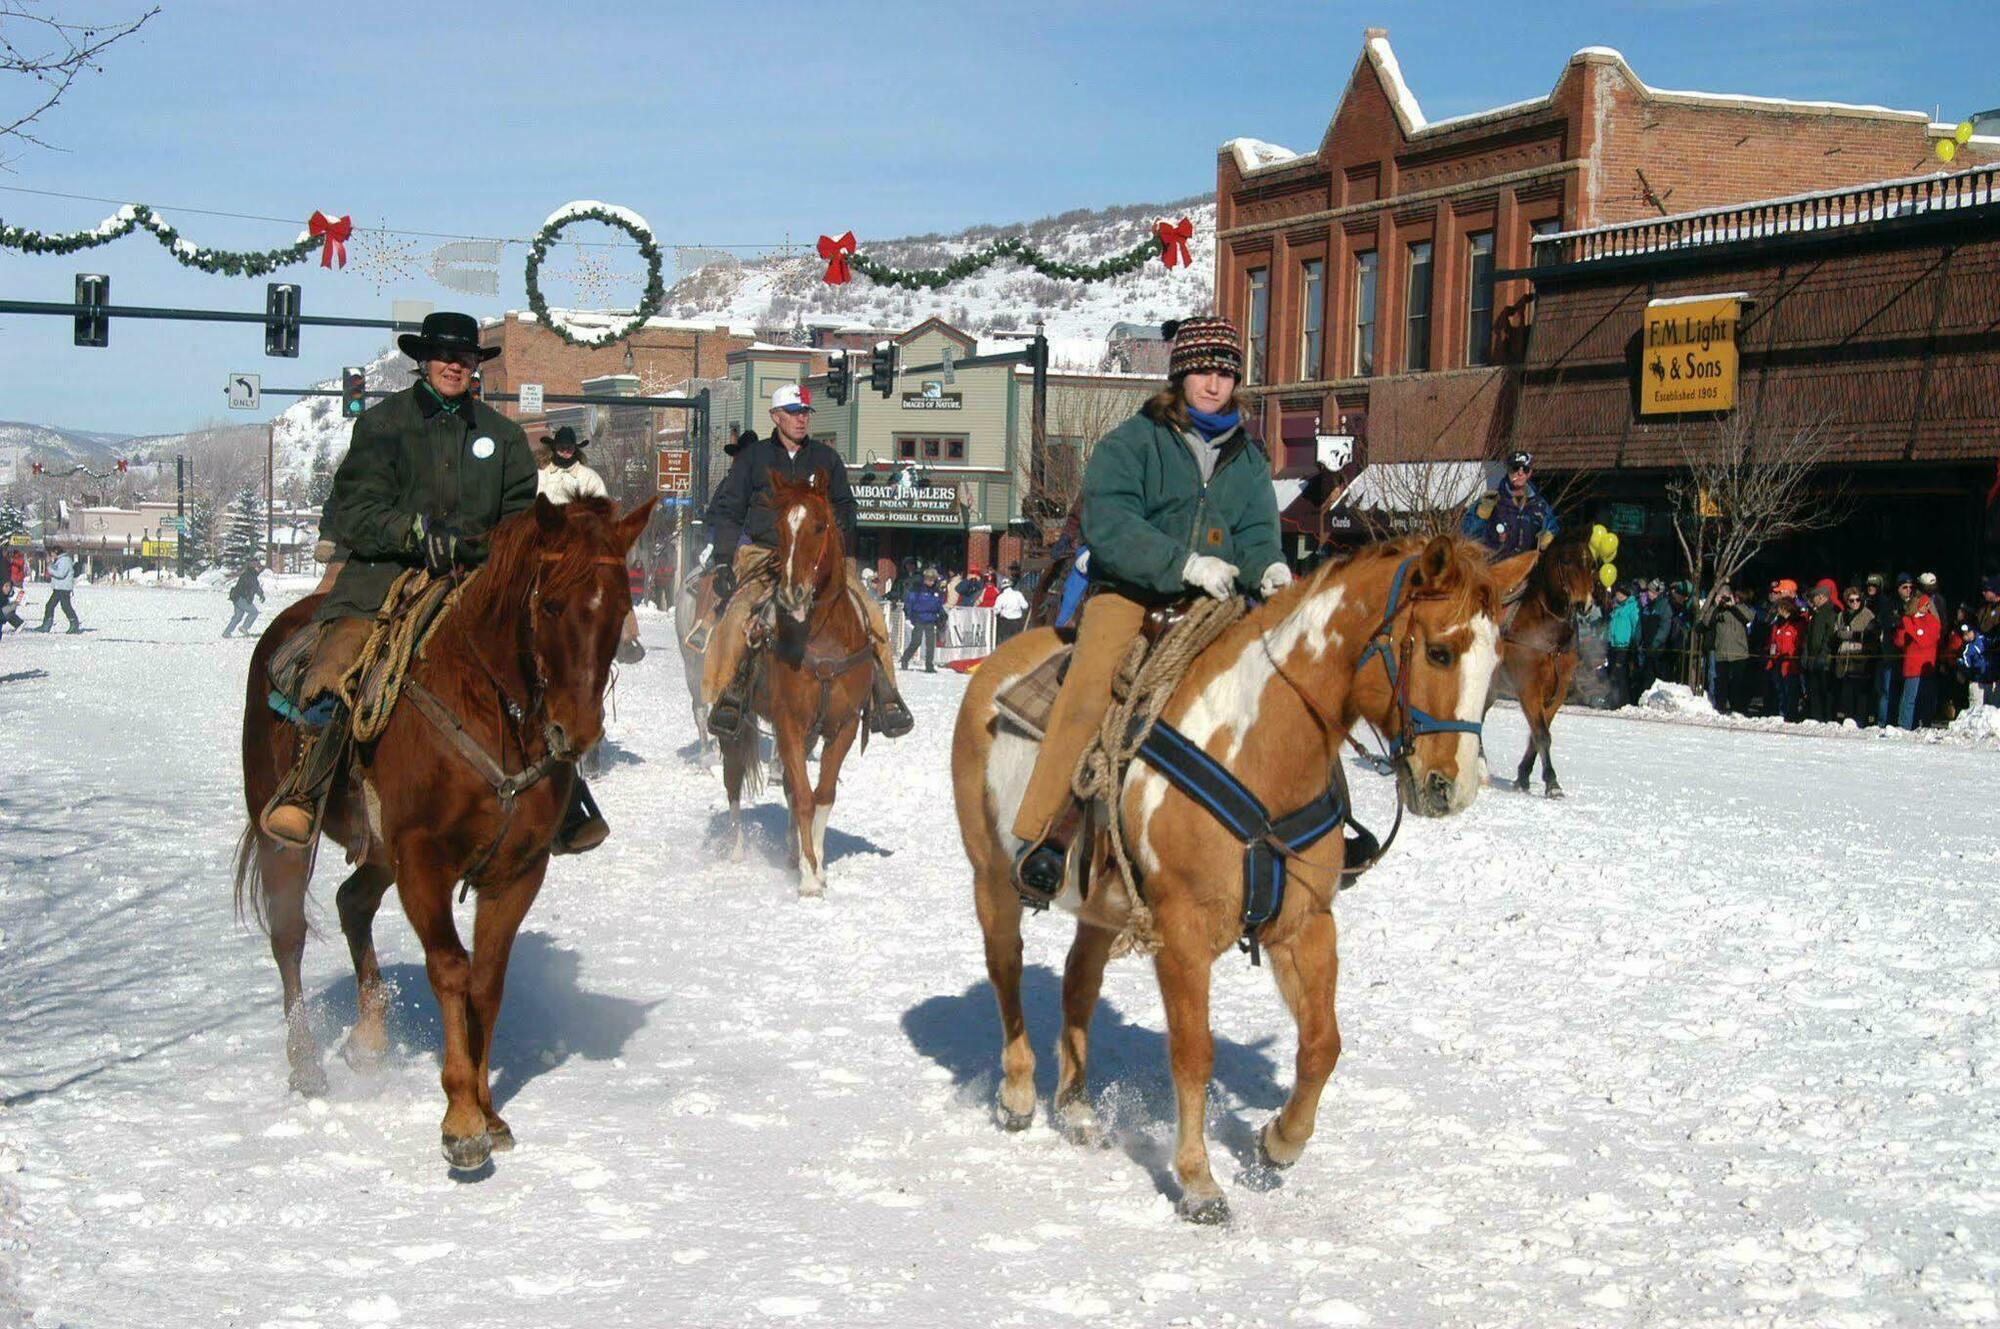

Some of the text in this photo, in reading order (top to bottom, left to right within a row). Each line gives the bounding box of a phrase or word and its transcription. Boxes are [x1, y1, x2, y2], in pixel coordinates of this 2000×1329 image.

[1650, 316, 1727, 351] F.M. Light
[1670, 352, 1722, 380] & Sons
[1654, 387, 1718, 402] Established 1905
[233, 399, 255, 407] ONLY
[903, 400, 925, 409] IMAGES
[894, 484, 956, 500] JEWELERS
[879, 500, 908, 508] INDIAN
[912, 501, 951, 510] JEWELRY
[921, 513, 959, 523] CRYSTALS
